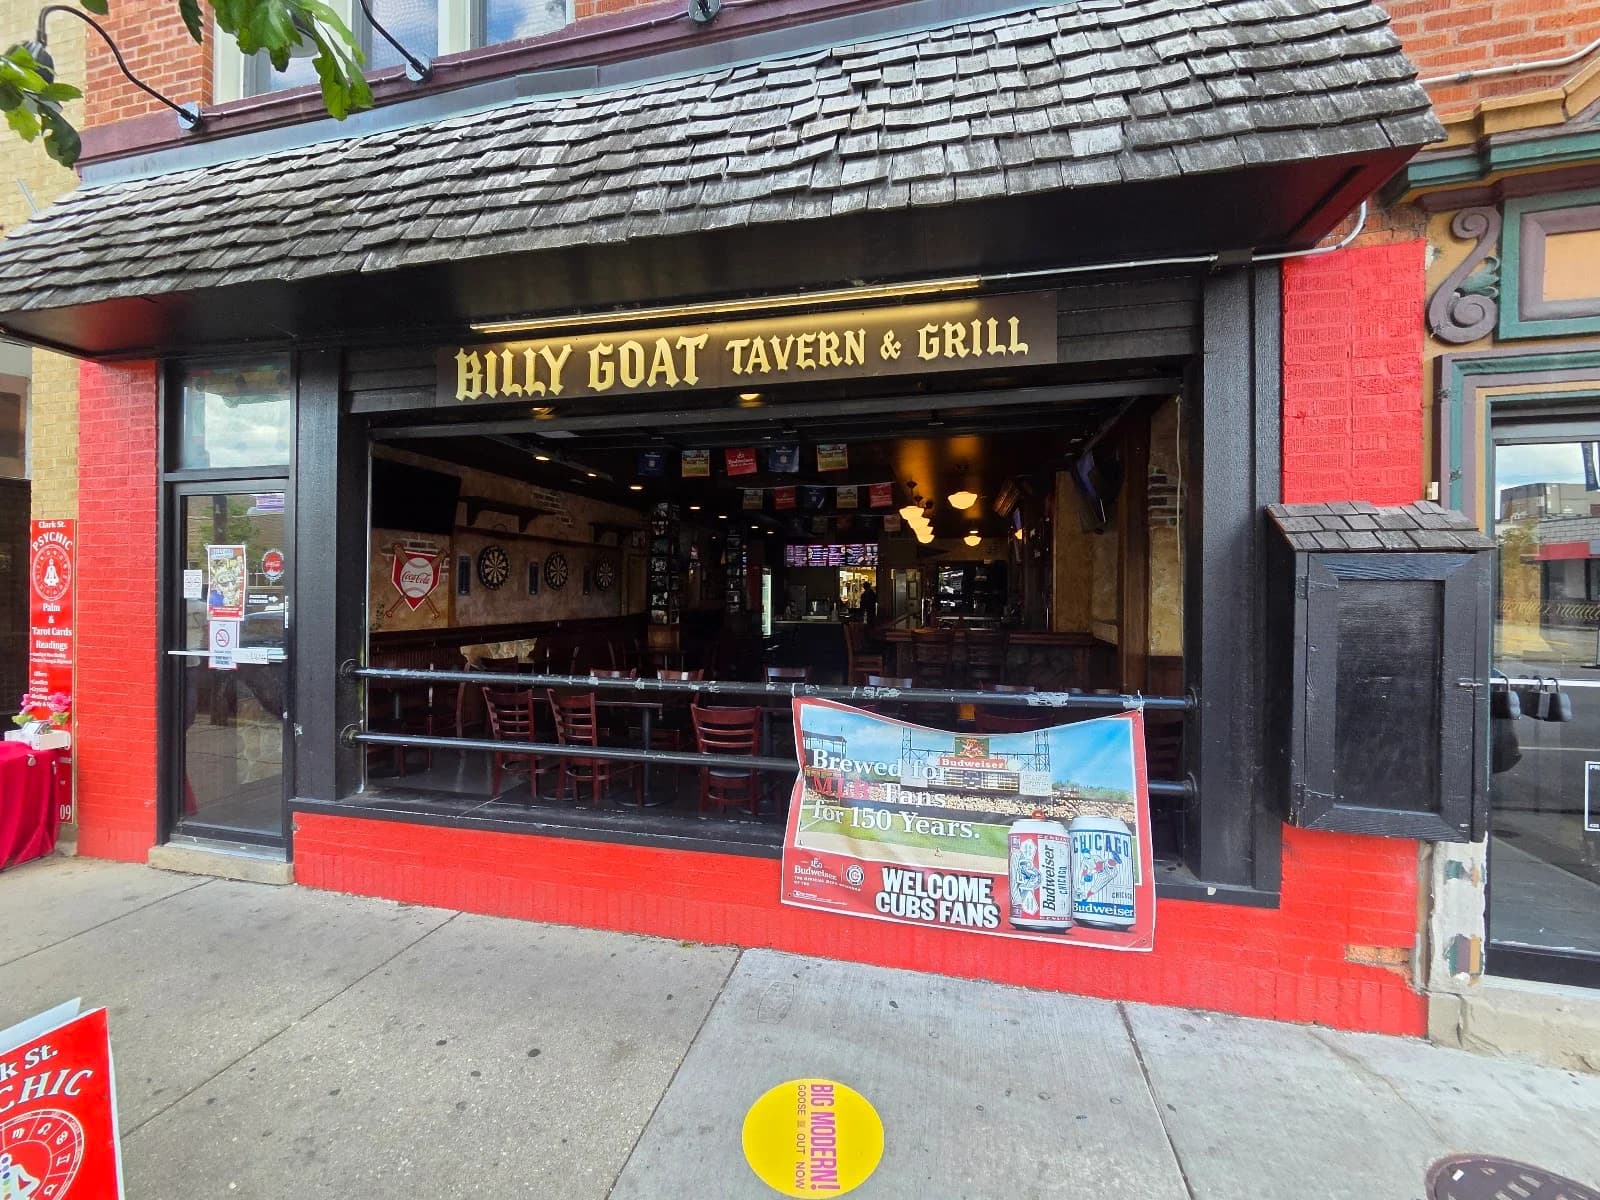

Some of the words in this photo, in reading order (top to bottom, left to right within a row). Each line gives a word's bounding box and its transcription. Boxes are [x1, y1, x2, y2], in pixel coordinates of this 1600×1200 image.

[454, 344, 572, 402] BILLY
[588, 334, 708, 392] GOAT
[725, 328, 866, 375] TAVERN
[880, 329, 901, 360] &
[917, 316, 1029, 360] GRILL
[38, 520, 56, 529] Clark
[32, 531, 73, 552] PSYCHIC
[43, 603, 61, 612] Palm
[48, 615, 55, 624] &
[32, 626, 51, 636] Tarot
[51, 627, 73, 636] Cards
[36, 640, 69, 651] Readings
[812, 748, 902, 777] Brewed
[912, 759, 946, 780] for
[941, 757, 1005, 769] Budweiser
[882, 782, 946, 808] Fans
[813, 799, 844, 824] for
[849, 806, 892, 831] 150
[899, 810, 980, 839] Years.
[1072, 834, 1129, 858] CHICAGO
[794, 864, 838, 881] Budweiser
[1042, 844, 1056, 912] Budweiser
[1057, 866, 1068, 895] CHICAGO
[881, 867, 993, 904] WELCOME
[875, 891, 936, 921] CUBS
[939, 900, 999, 929] FANS
[1072, 902, 1134, 917] Budweiser
[24, 1044, 58, 1070] St.
[797, 1084, 806, 1116] GOOSE
[810, 1083, 835, 1107] BIG
[796, 1133, 806, 1155] OUT
[810, 1111, 841, 1191] MODERN!
[795, 1161, 806, 1190] NOW
